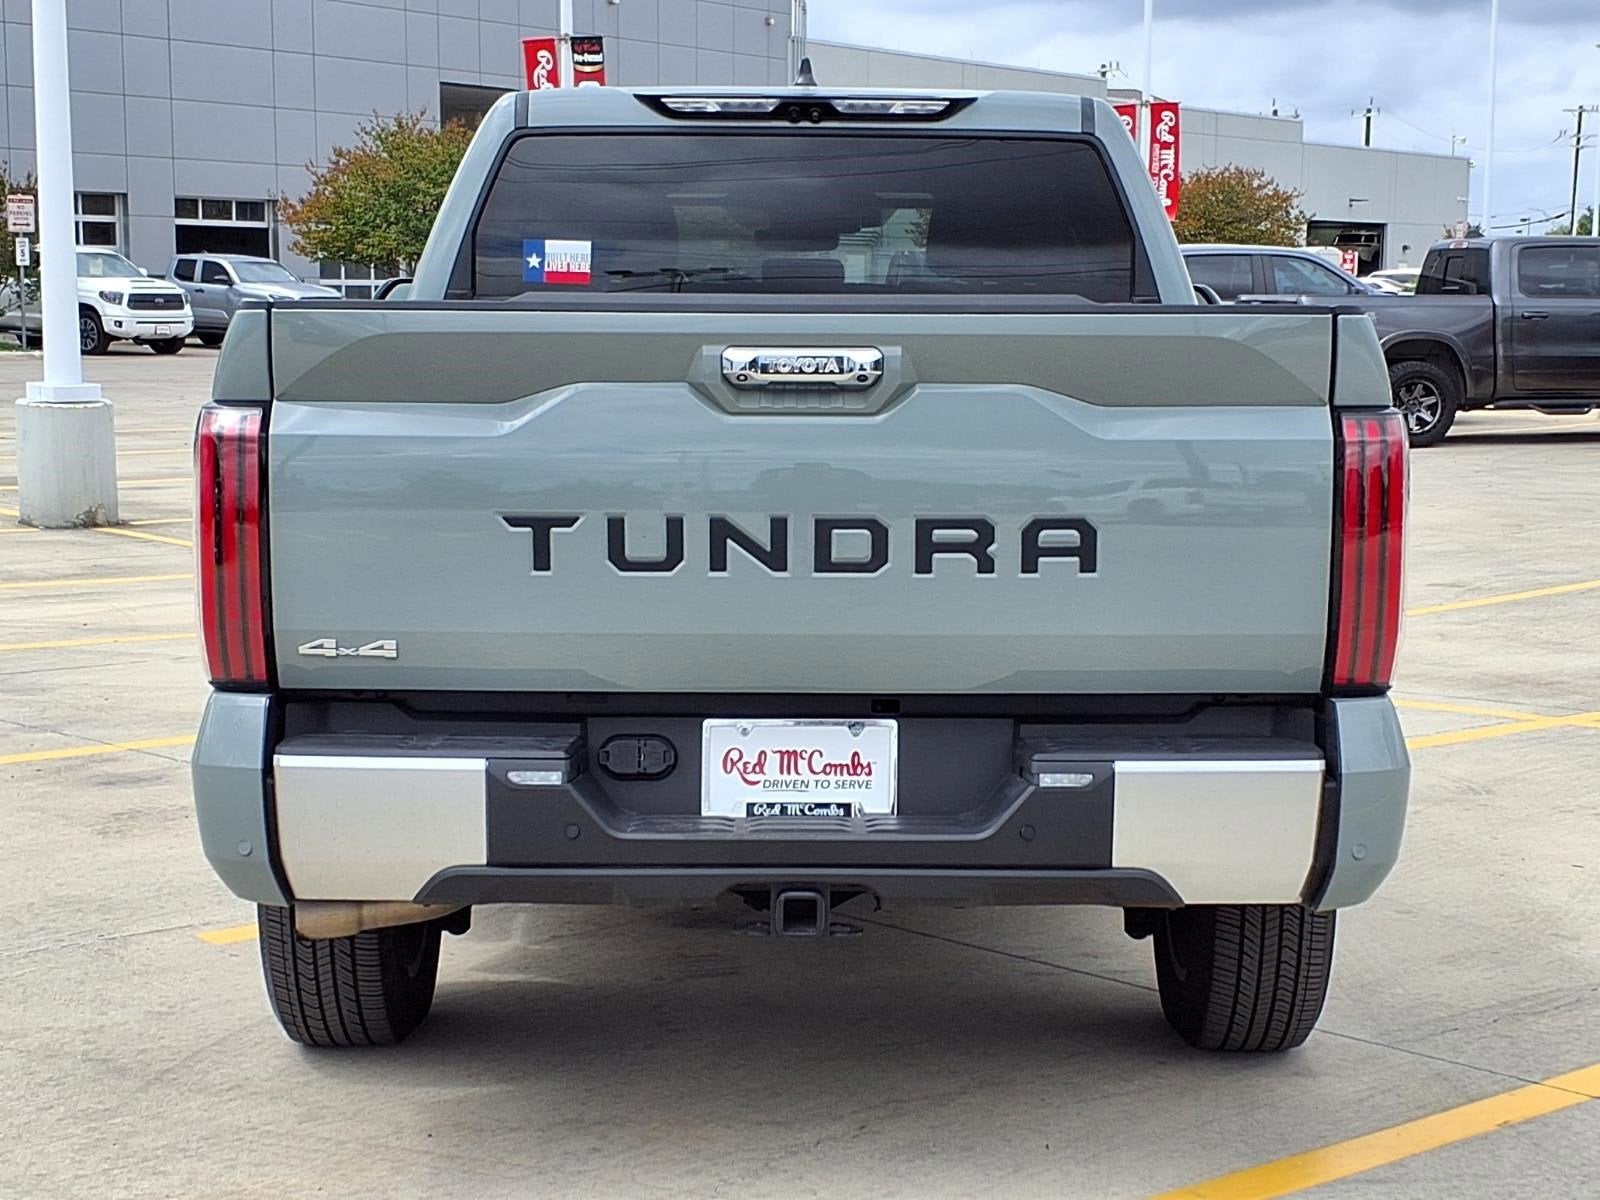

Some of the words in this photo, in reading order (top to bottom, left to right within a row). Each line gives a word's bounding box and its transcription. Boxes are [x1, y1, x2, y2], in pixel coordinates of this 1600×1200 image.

[1156, 110, 1176, 143] Red
[1151, 143, 1160, 173] DRIVEN
[1159, 144, 1175, 207] McComb
[767, 358, 839, 373] TOYOTA
[498, 514, 1099, 578] TUNDRA
[298, 638, 397, 658] 4x4
[722, 747, 767, 786] Red
[772, 749, 873, 777] McCombs
[762, 779, 810, 790] DRIVEN
[813, 779, 831, 790] TO
[833, 779, 873, 790] SERVE
[753, 803, 781, 817] Red
[783, 803, 844, 817] McCombs
